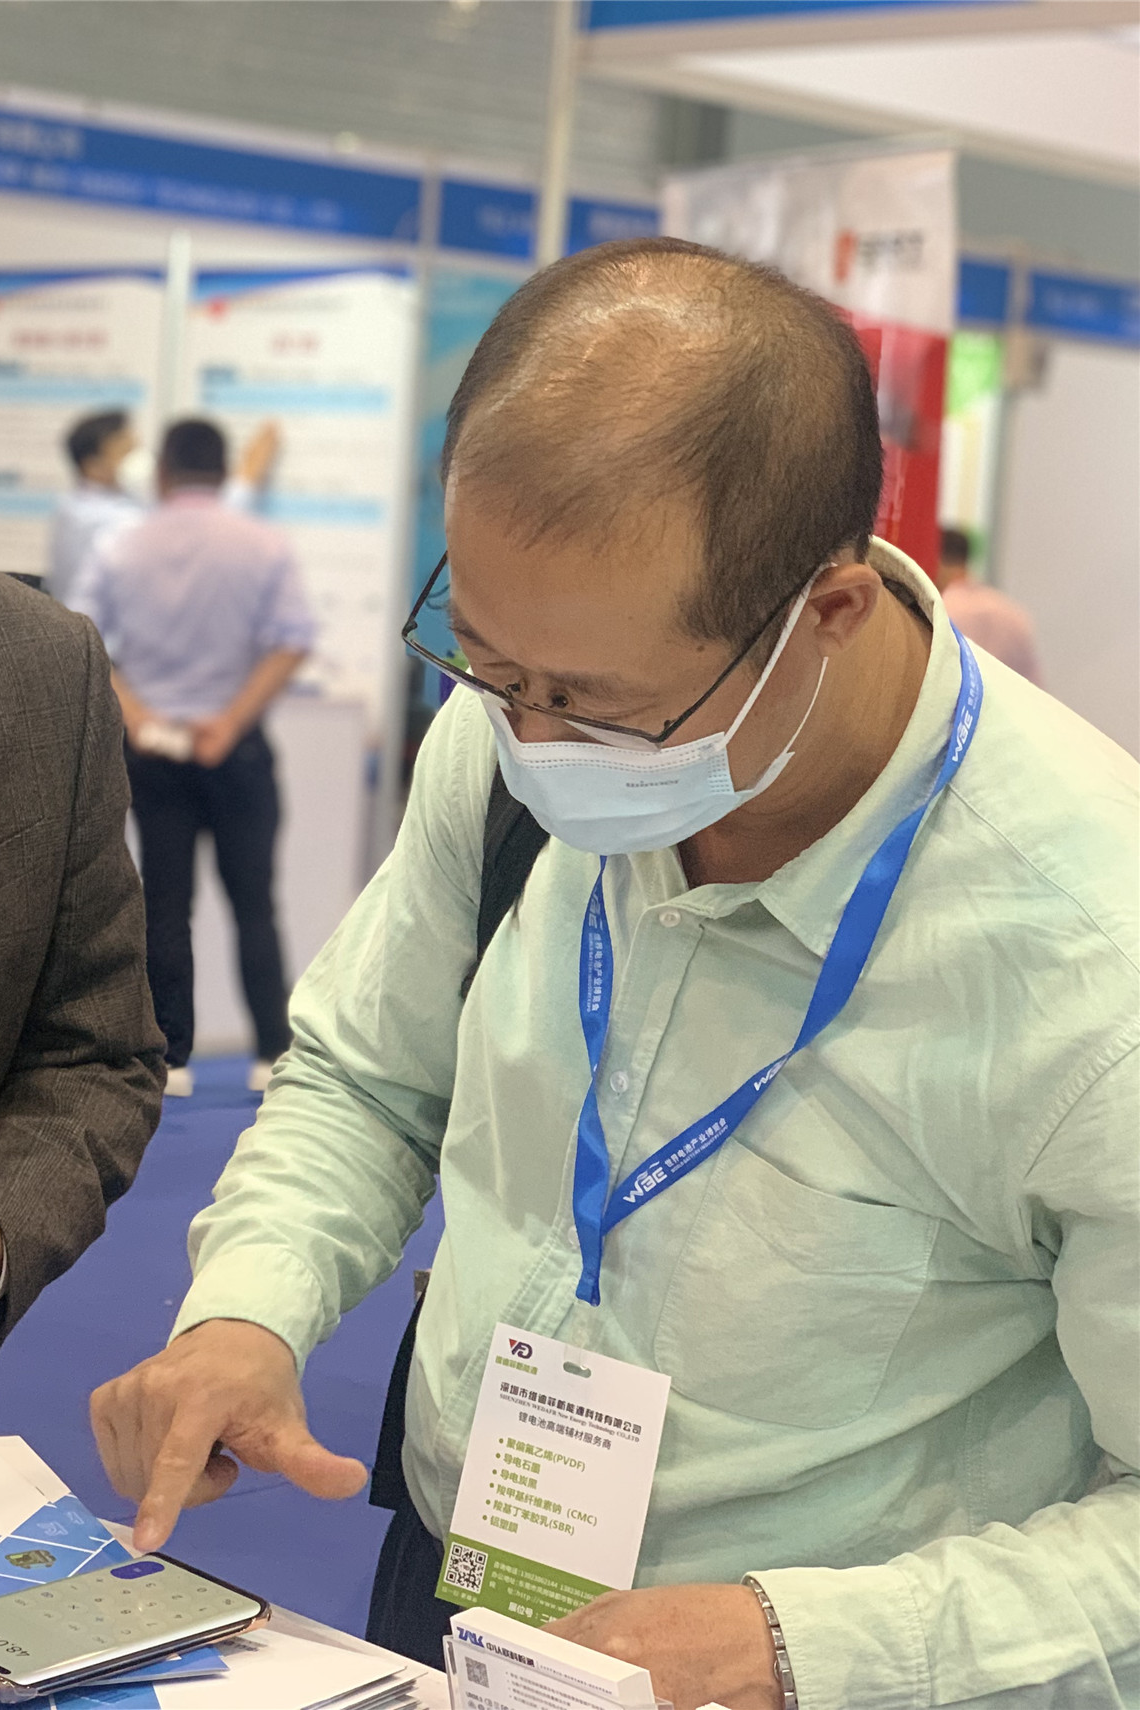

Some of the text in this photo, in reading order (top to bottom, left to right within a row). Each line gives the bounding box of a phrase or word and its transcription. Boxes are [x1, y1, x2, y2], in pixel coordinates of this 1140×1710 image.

[663, 1116, 727, 1168] 世界电池产业博览会
[502, 1452, 541, 1474] 导电石墨
